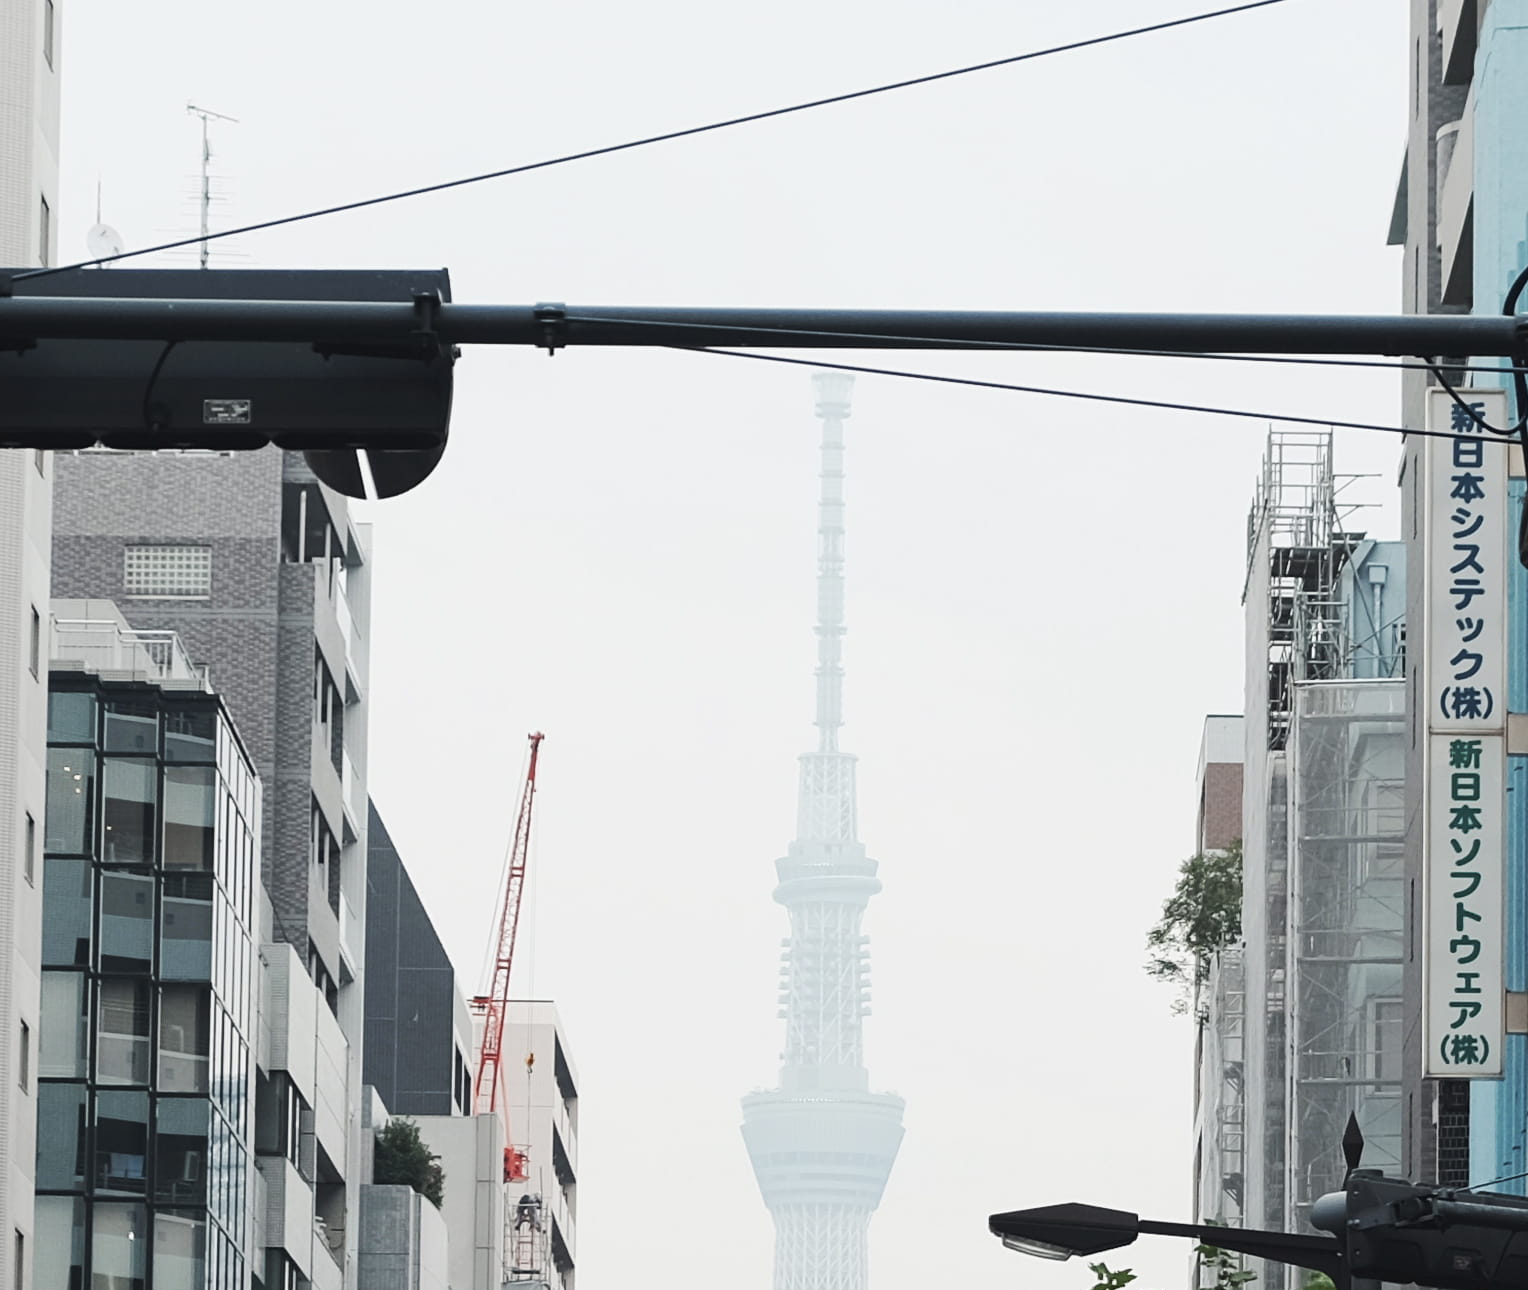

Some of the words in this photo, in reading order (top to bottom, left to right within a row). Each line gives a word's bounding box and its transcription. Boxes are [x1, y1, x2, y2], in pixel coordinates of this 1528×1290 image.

[1439, 402, 1493, 720] 新日本システック(株)
[1440, 739, 1490, 1065] 新日本ソフトウェア(株)
